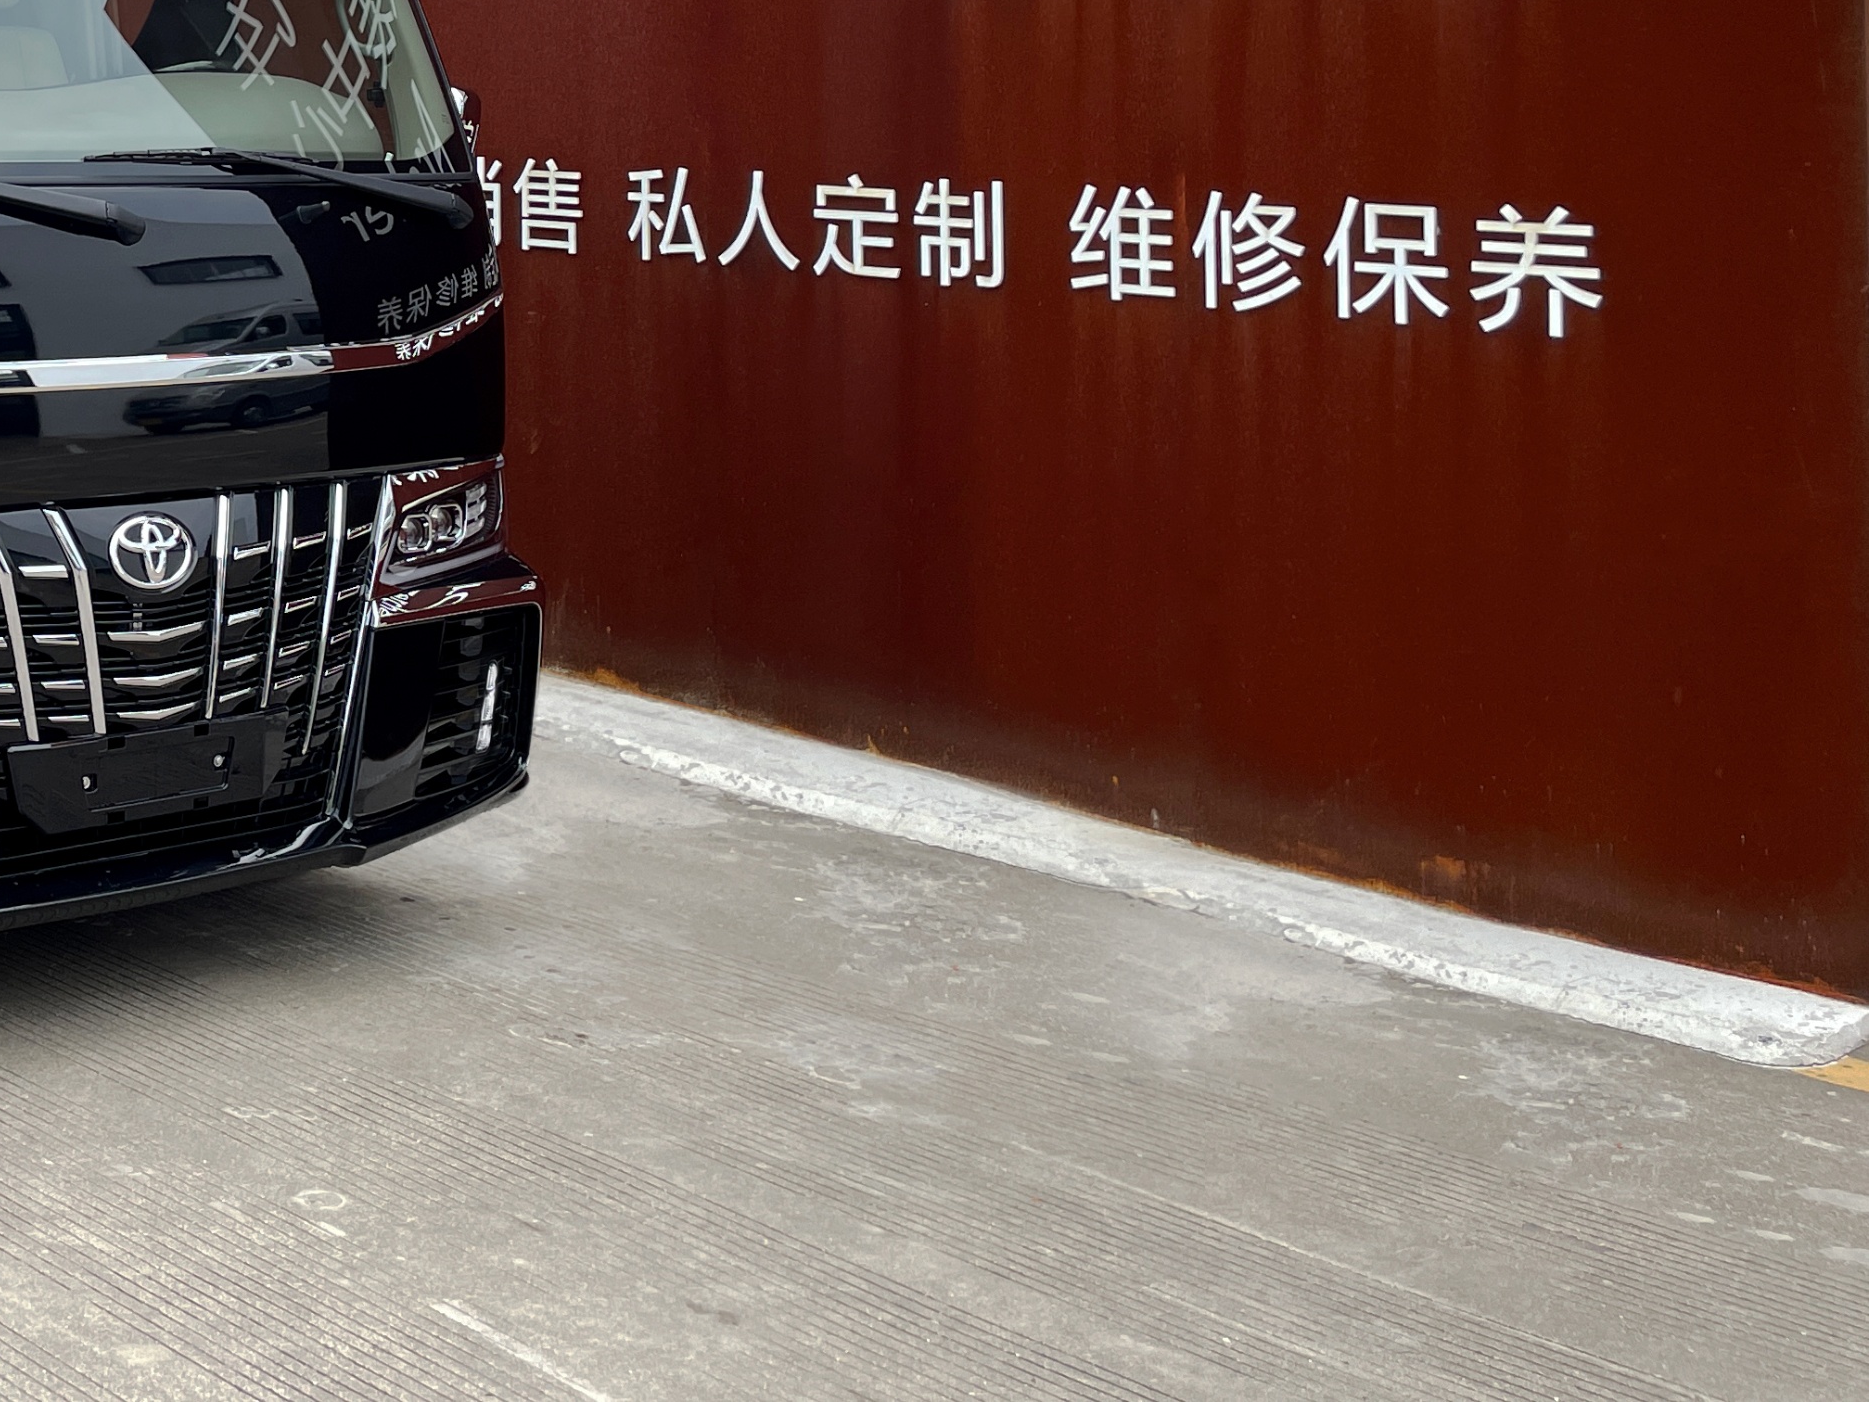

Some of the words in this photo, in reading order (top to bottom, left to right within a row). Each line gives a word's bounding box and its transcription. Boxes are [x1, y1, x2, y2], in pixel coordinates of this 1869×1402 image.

[626, 165, 1004, 290] 私人定制
[1067, 182, 1605, 339] 维修保养
